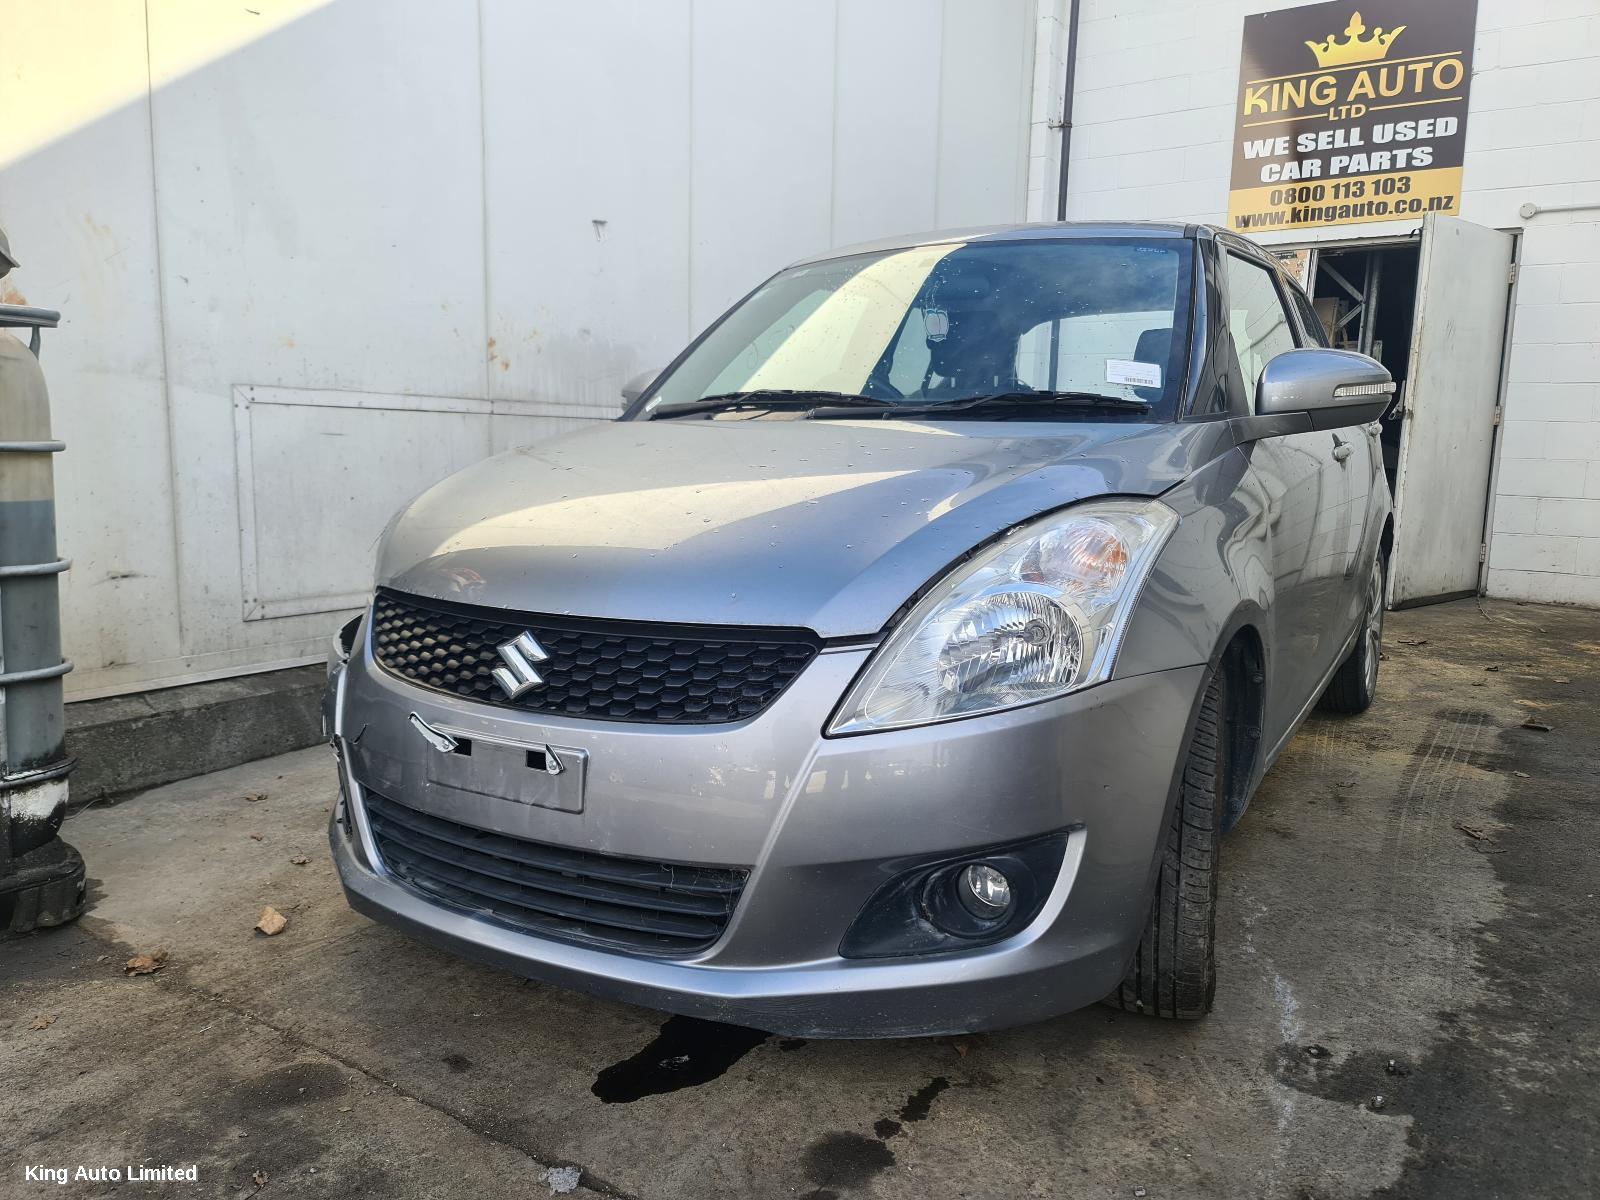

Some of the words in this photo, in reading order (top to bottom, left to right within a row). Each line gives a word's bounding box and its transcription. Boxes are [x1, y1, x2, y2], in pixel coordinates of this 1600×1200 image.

[1243, 75, 1338, 116] KING
[1347, 58, 1464, 102] AUTO
[1328, 103, 1367, 121] LTD
[1243, 136, 1290, 159] WE
[1296, 127, 1365, 153] SELL
[1372, 116, 1459, 144] USED
[1260, 158, 1322, 183] CAR
[1330, 146, 1433, 176] PARTS
[1270, 184, 1326, 207] 0800
[1330, 180, 1366, 201] 113
[1371, 176, 1411, 197] 103
[1235, 195, 1454, 229] www.kingauto.co.nz
